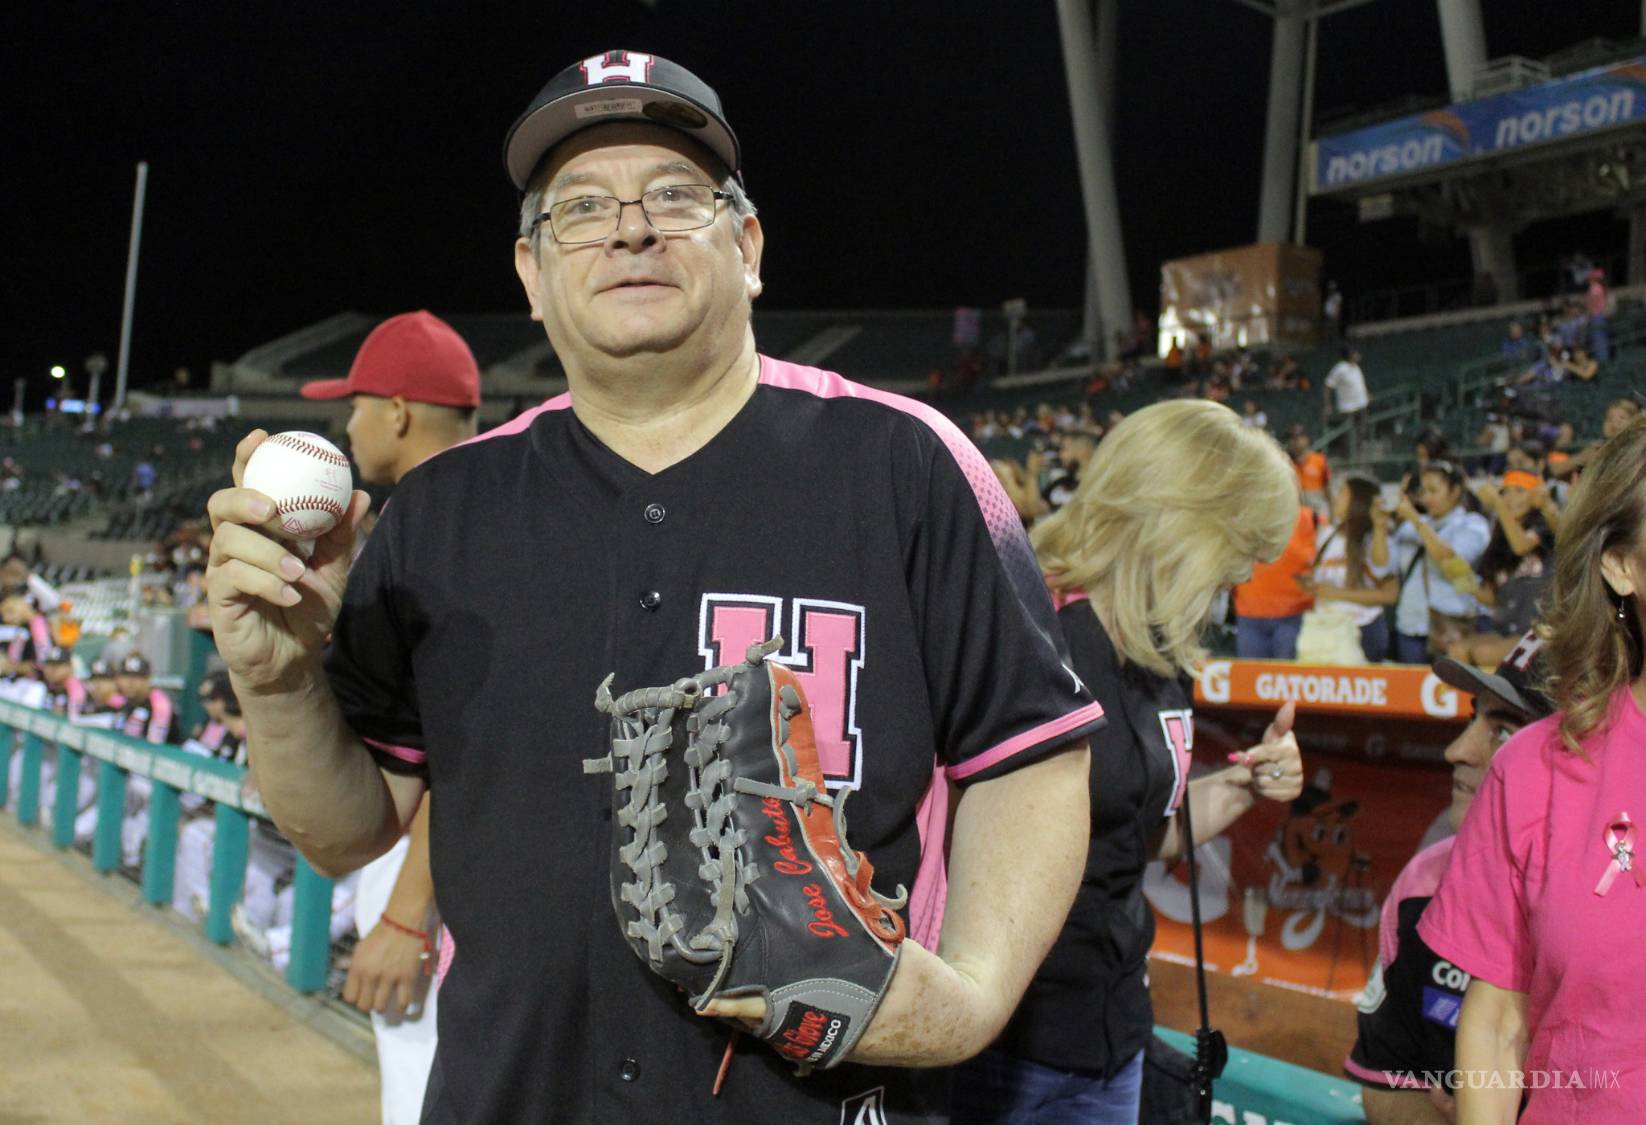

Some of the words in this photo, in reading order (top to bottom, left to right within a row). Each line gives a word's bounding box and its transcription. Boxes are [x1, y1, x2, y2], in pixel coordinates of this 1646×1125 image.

[579, 49, 655, 86] H
[1495, 89, 1635, 149] norson
[1326, 134, 1446, 184] norson
[698, 593, 866, 791] H
[1201, 661, 1232, 703] G
[1255, 673, 1387, 706] GATORADE
[1420, 673, 1458, 718] G
[1432, 961, 1471, 991] Co
